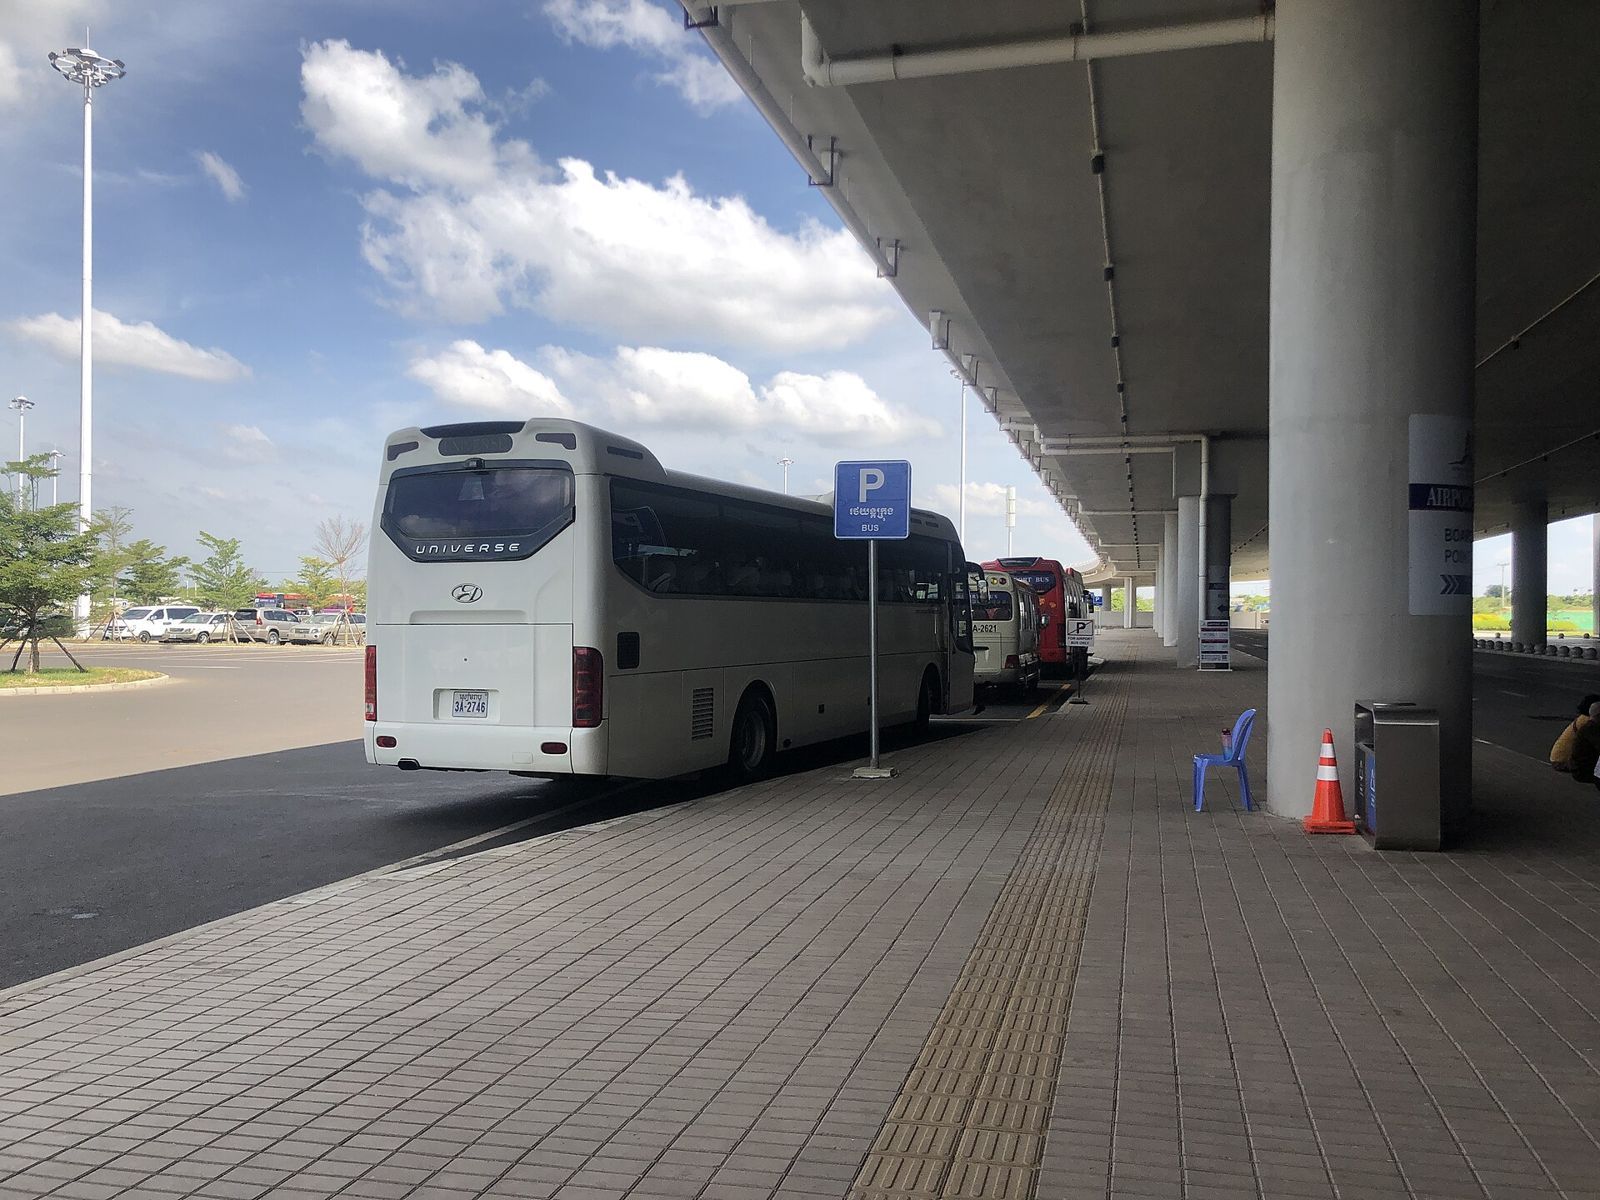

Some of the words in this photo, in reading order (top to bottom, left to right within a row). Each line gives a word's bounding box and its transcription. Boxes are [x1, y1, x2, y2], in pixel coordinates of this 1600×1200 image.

[859, 468, 884, 503] P
[861, 524, 879, 532] BUS
[416, 543, 520, 554] UNIVERSE
[1077, 622, 1086, 634] P
[454, 701, 486, 714] 3A-2746
